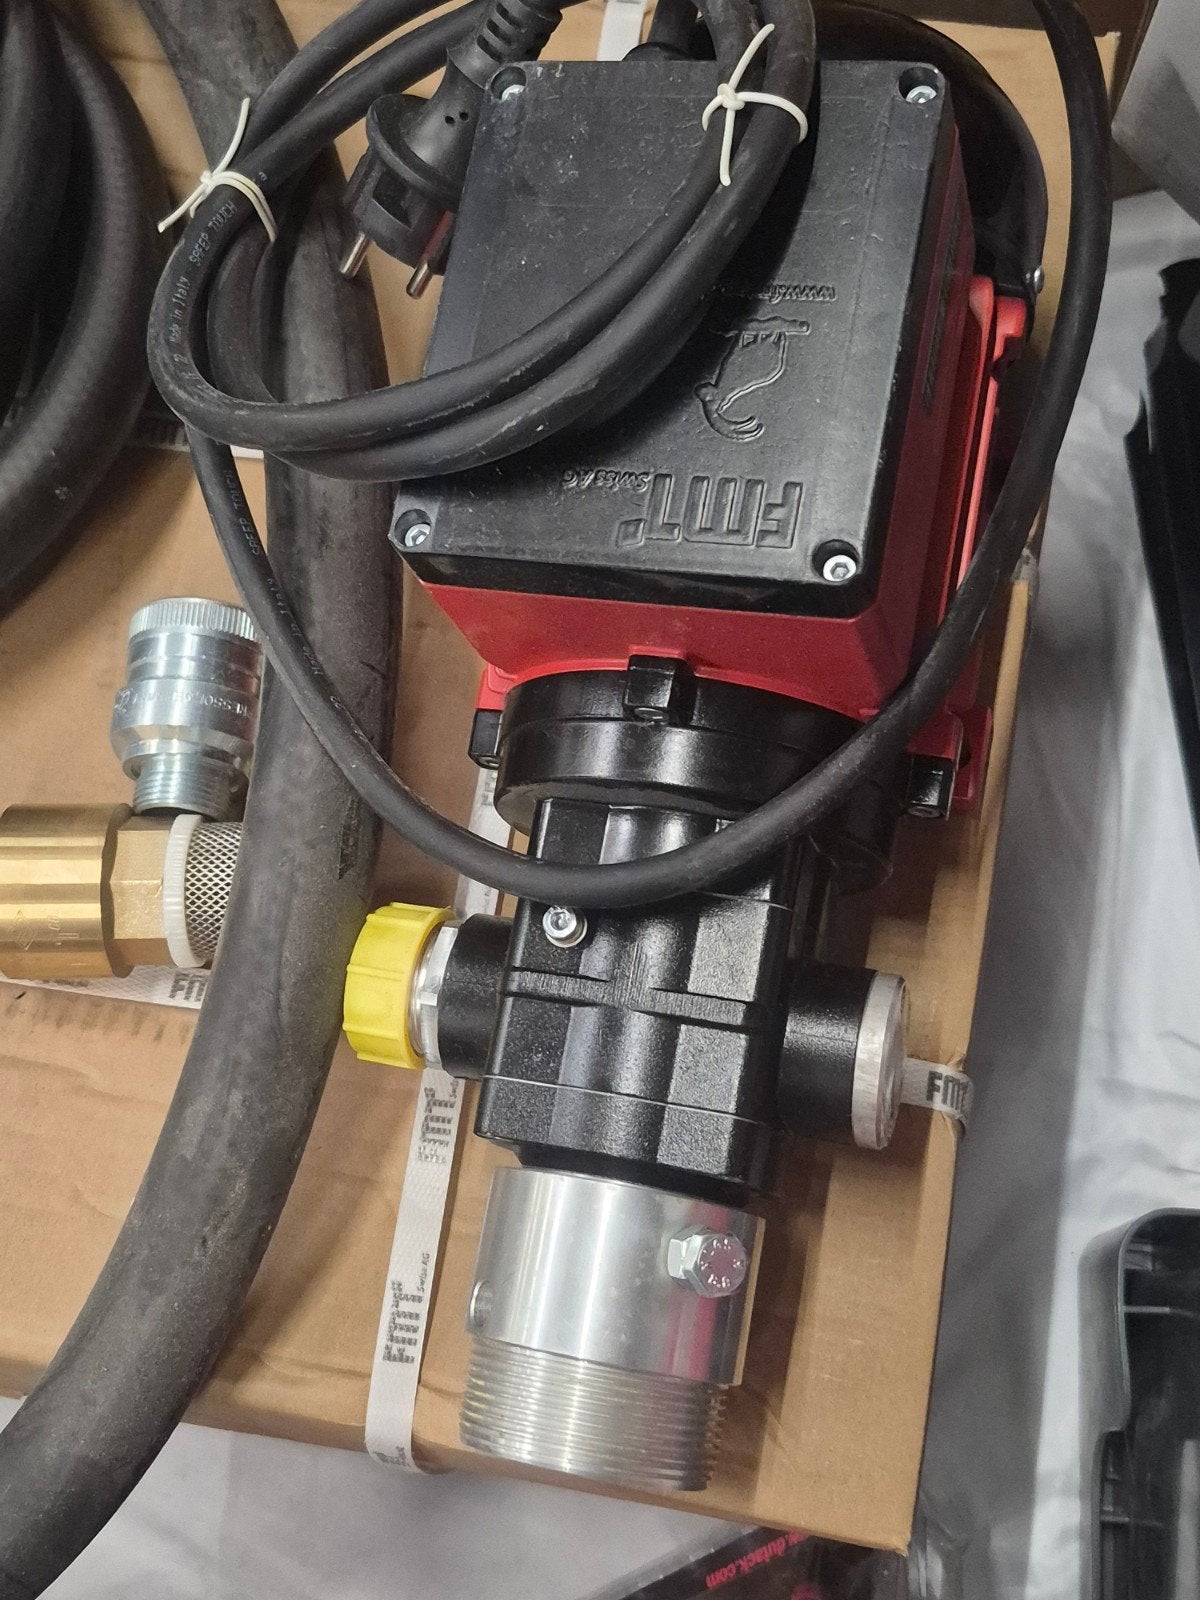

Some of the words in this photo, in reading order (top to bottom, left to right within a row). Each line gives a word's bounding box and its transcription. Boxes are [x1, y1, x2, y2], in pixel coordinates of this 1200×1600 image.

[172, 275, 191, 305] Italy
[208, 200, 239, 234] TOUCH
[616, 472, 804, 550] FMT
[168, 970, 209, 1002] FM
[382, 1280, 424, 1364] FMT
